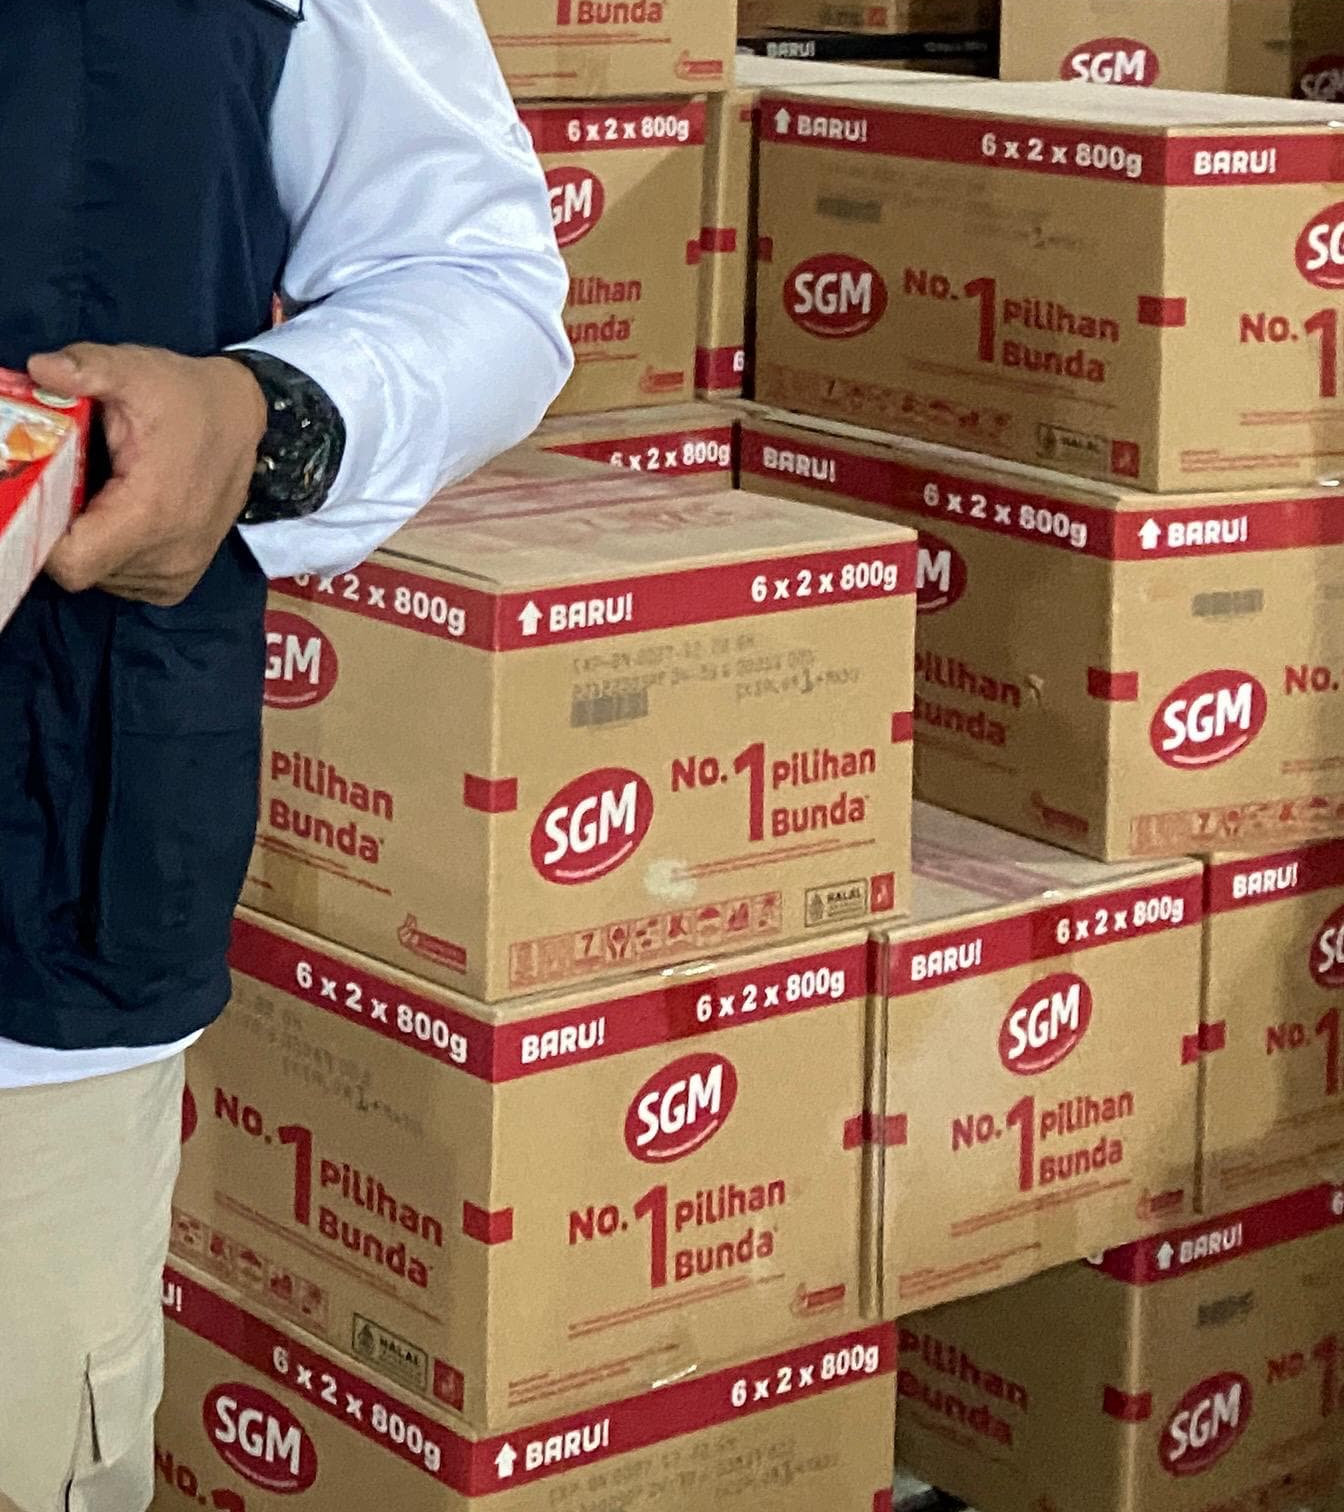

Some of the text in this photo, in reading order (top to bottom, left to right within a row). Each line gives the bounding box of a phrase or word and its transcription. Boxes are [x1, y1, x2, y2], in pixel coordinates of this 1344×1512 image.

[766, 41, 815, 57] BARU!
[1071, 49, 1146, 85] SGM
[1193, 148, 1277, 176] BARU!
[792, 271, 873, 315] SGM
[1239, 307, 1338, 398] No. 1
[1167, 516, 1248, 548] BARU!
[549, 596, 633, 634] BARU!
[751, 574, 767, 602] 6
[773, 575, 791, 600] x
[792, 568, 812, 597] 2
[817, 568, 834, 593] x
[839, 560, 899, 594] 800g
[1162, 682, 1253, 752] SGM
[271, 750, 395, 823] Pilihan
[543, 780, 638, 866] SGM
[671, 742, 877, 842] No. 1 Pilihan
[269, 799, 380, 865] Bunda
[1232, 863, 1298, 900] BARU!
[911, 895, 1185, 981] BARU! 6 x 2 x 800g
[295, 960, 469, 1063] 6 x 2 x 800g
[520, 965, 846, 1064] BARU! 6 x 2 x 800g
[1008, 982, 1081, 1059] SGM
[637, 1066, 724, 1147] SGM
[952, 1090, 1134, 1192] No. 1 Pilihan
[214, 1086, 444, 1249] No. 1 Pilihan
[568, 1178, 786, 1289] No. 1 Pilihan
[1178, 1222, 1242, 1265] BARU!
[214, 1395, 302, 1476] SGM
[525, 1345, 880, 1467] BARU! 6 x 2 x 800g
[1169, 1384, 1242, 1464] SGM
